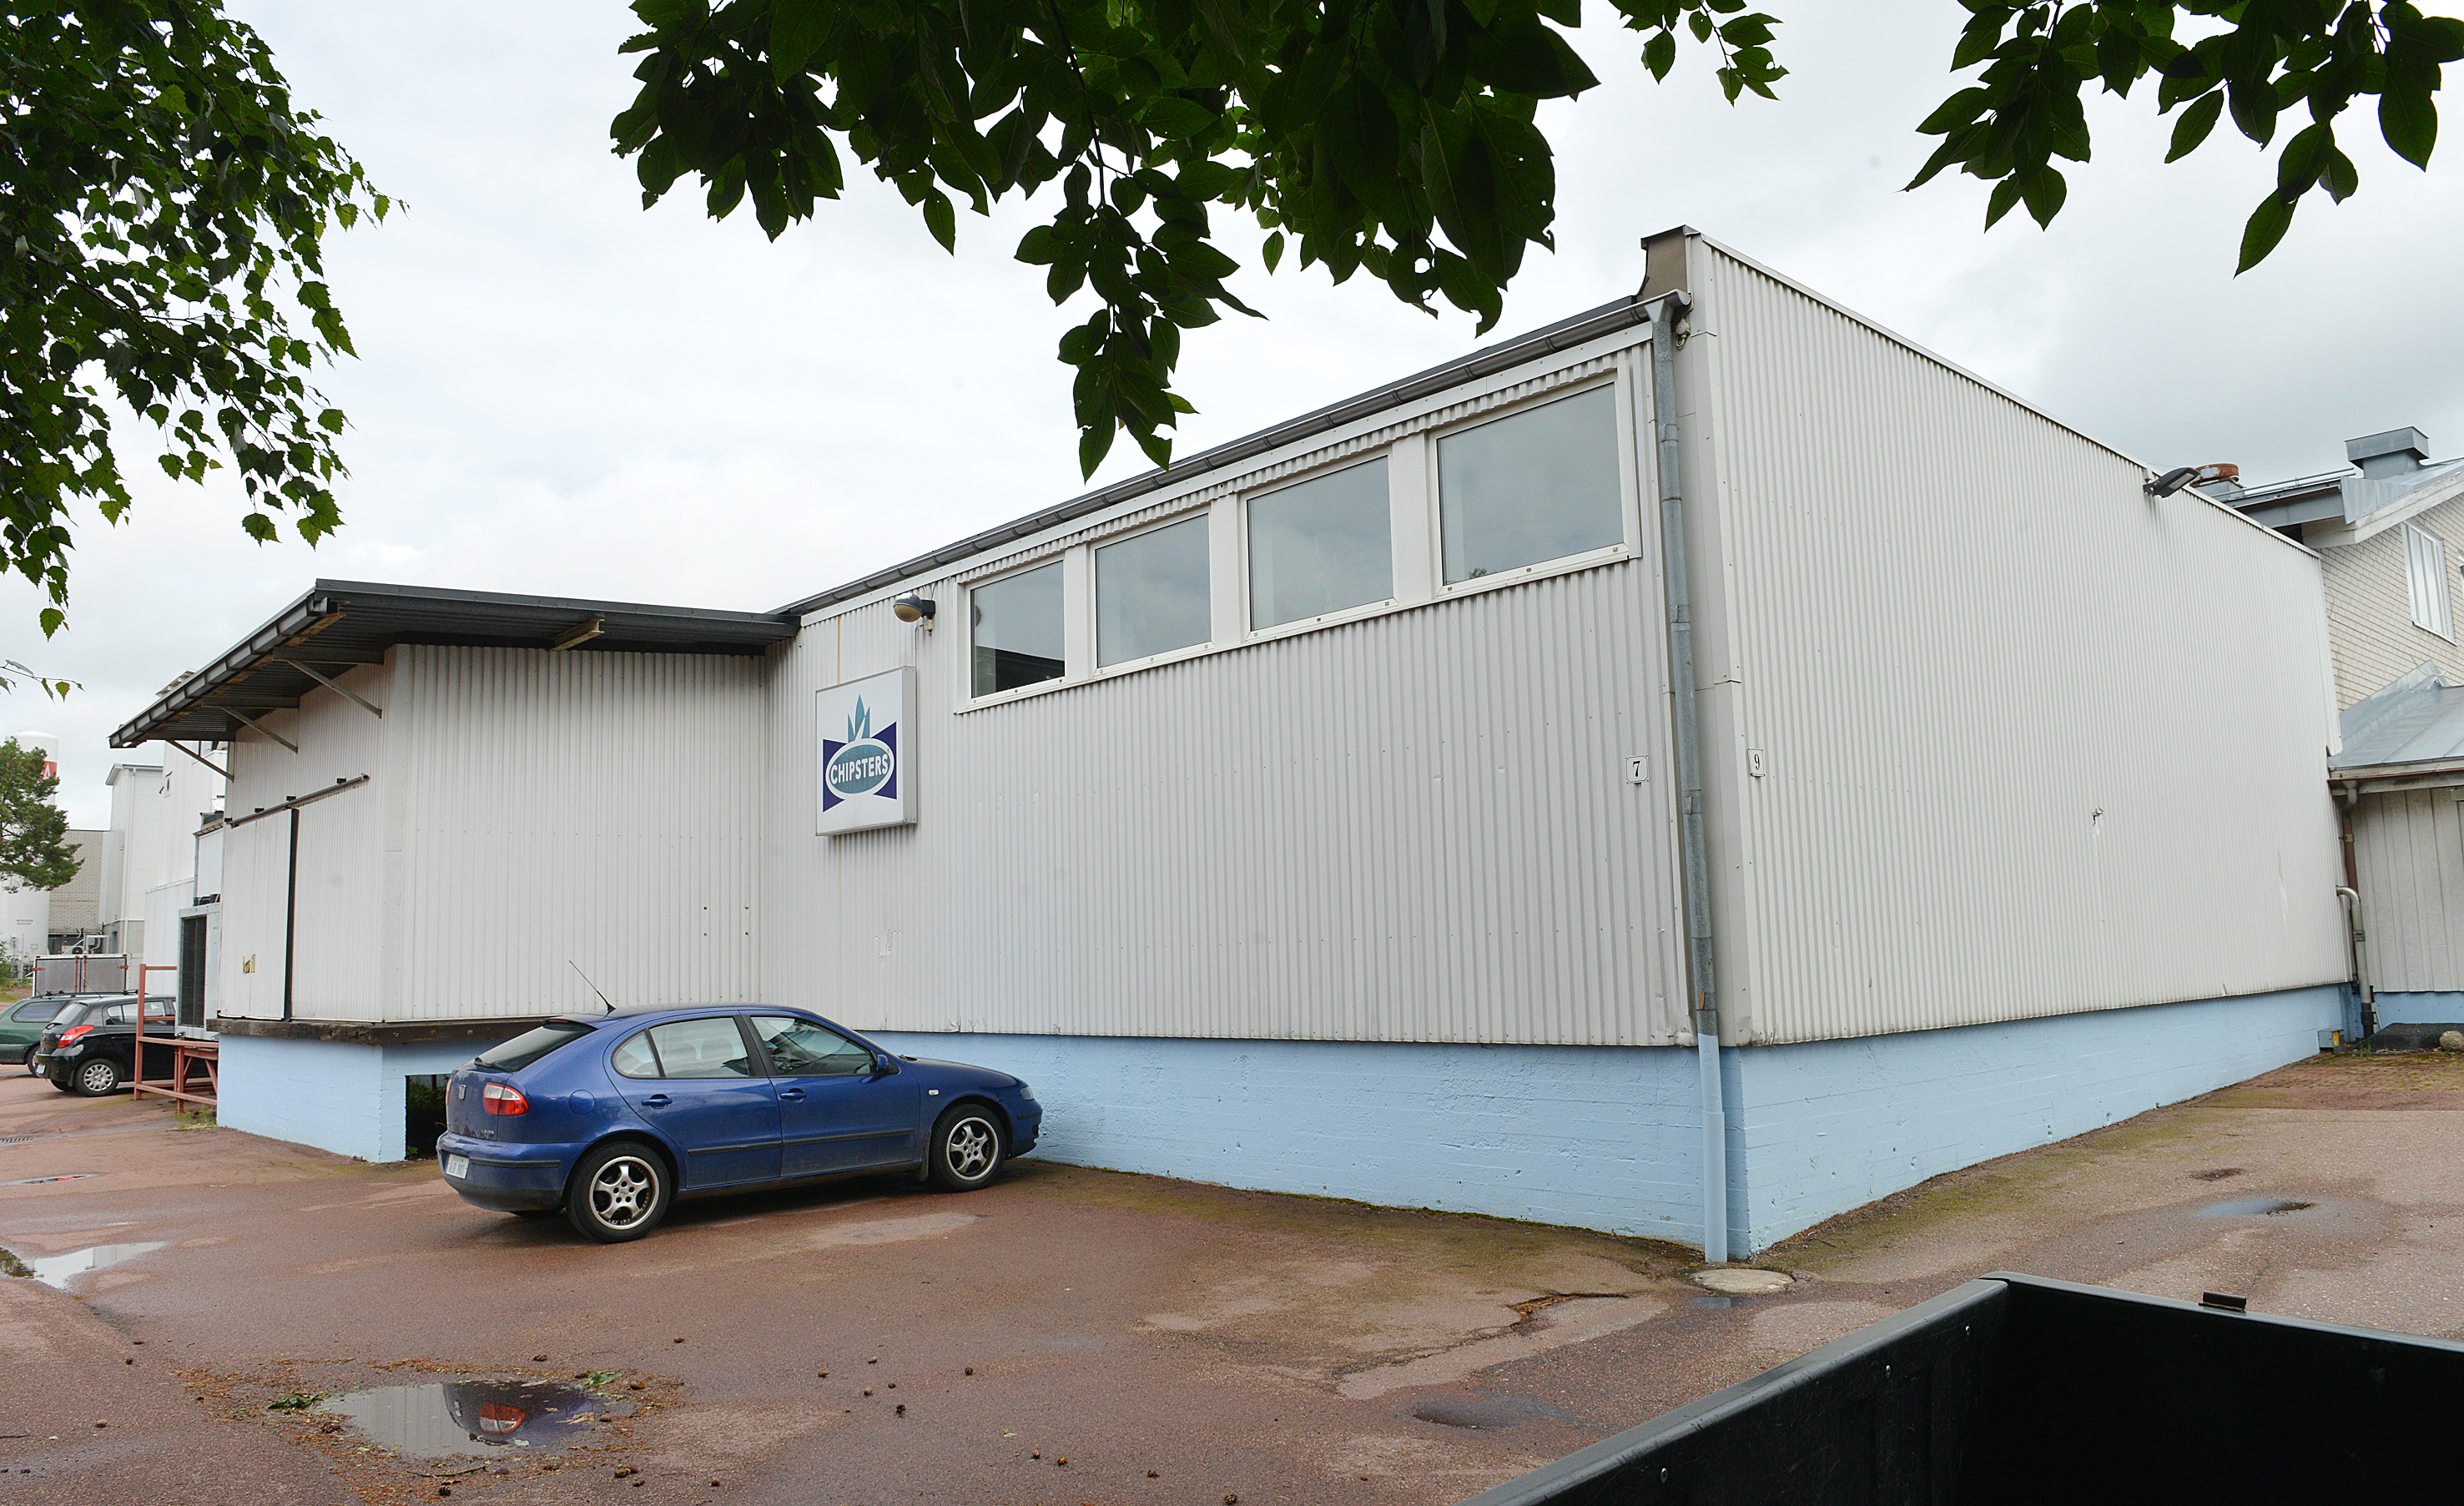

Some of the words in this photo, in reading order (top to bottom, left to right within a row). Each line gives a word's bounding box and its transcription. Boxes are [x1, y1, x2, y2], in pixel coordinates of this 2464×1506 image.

[830, 753, 889, 784] CHIPSTERS
[1632, 760, 1641, 778] 7
[1754, 753, 1761, 770] 9
